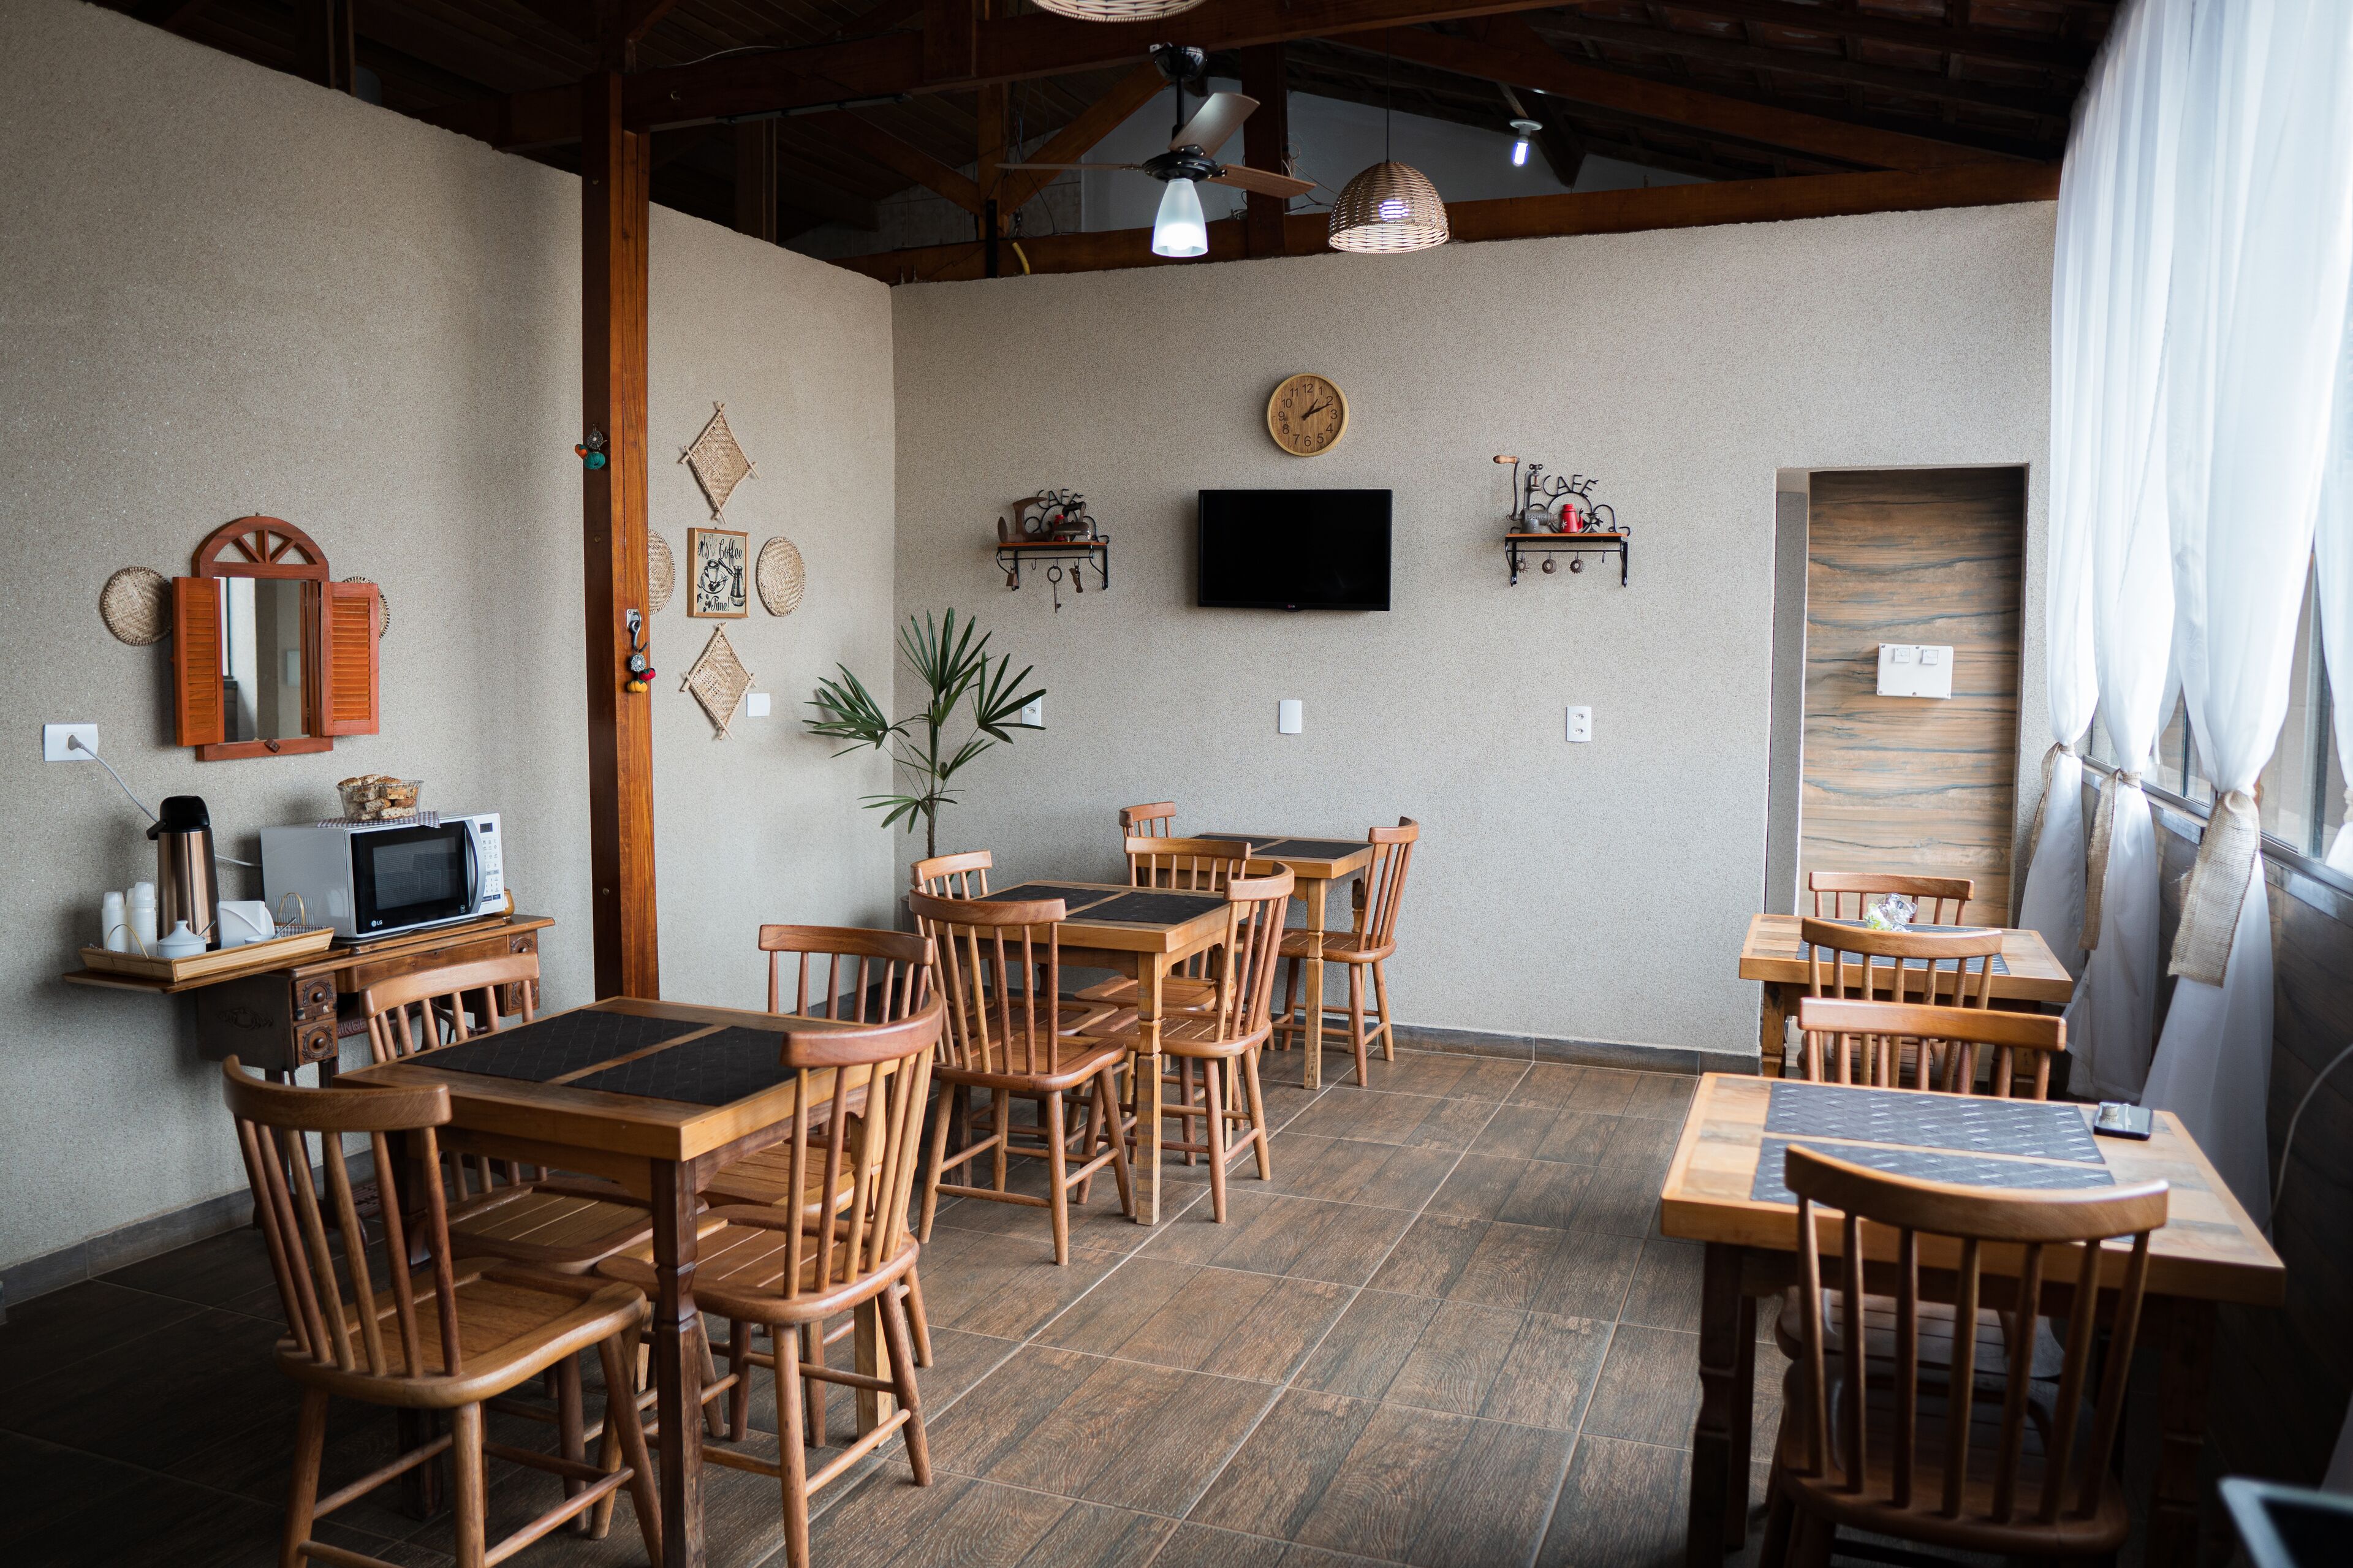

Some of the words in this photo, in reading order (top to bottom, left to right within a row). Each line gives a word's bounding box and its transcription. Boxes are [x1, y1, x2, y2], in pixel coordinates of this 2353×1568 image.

[1290, 388, 1298, 397] 11
[1303, 384, 1313, 393] 12
[1319, 387, 1322, 395] 1
[1282, 398, 1292, 408] 10
[1326, 396, 1333, 405] 2
[1278, 411, 1285, 421] 9
[1330, 409, 1338, 419] 3
[1283, 423, 1289, 434] 8
[1326, 423, 1333, 433] 4
[1293, 434, 1300, 445] 7
[1304, 436, 1311, 447] 6
[1317, 433, 1324, 444] 5
[719, 538, 742, 567] Coffee
[711, 596, 730, 611] Time!
